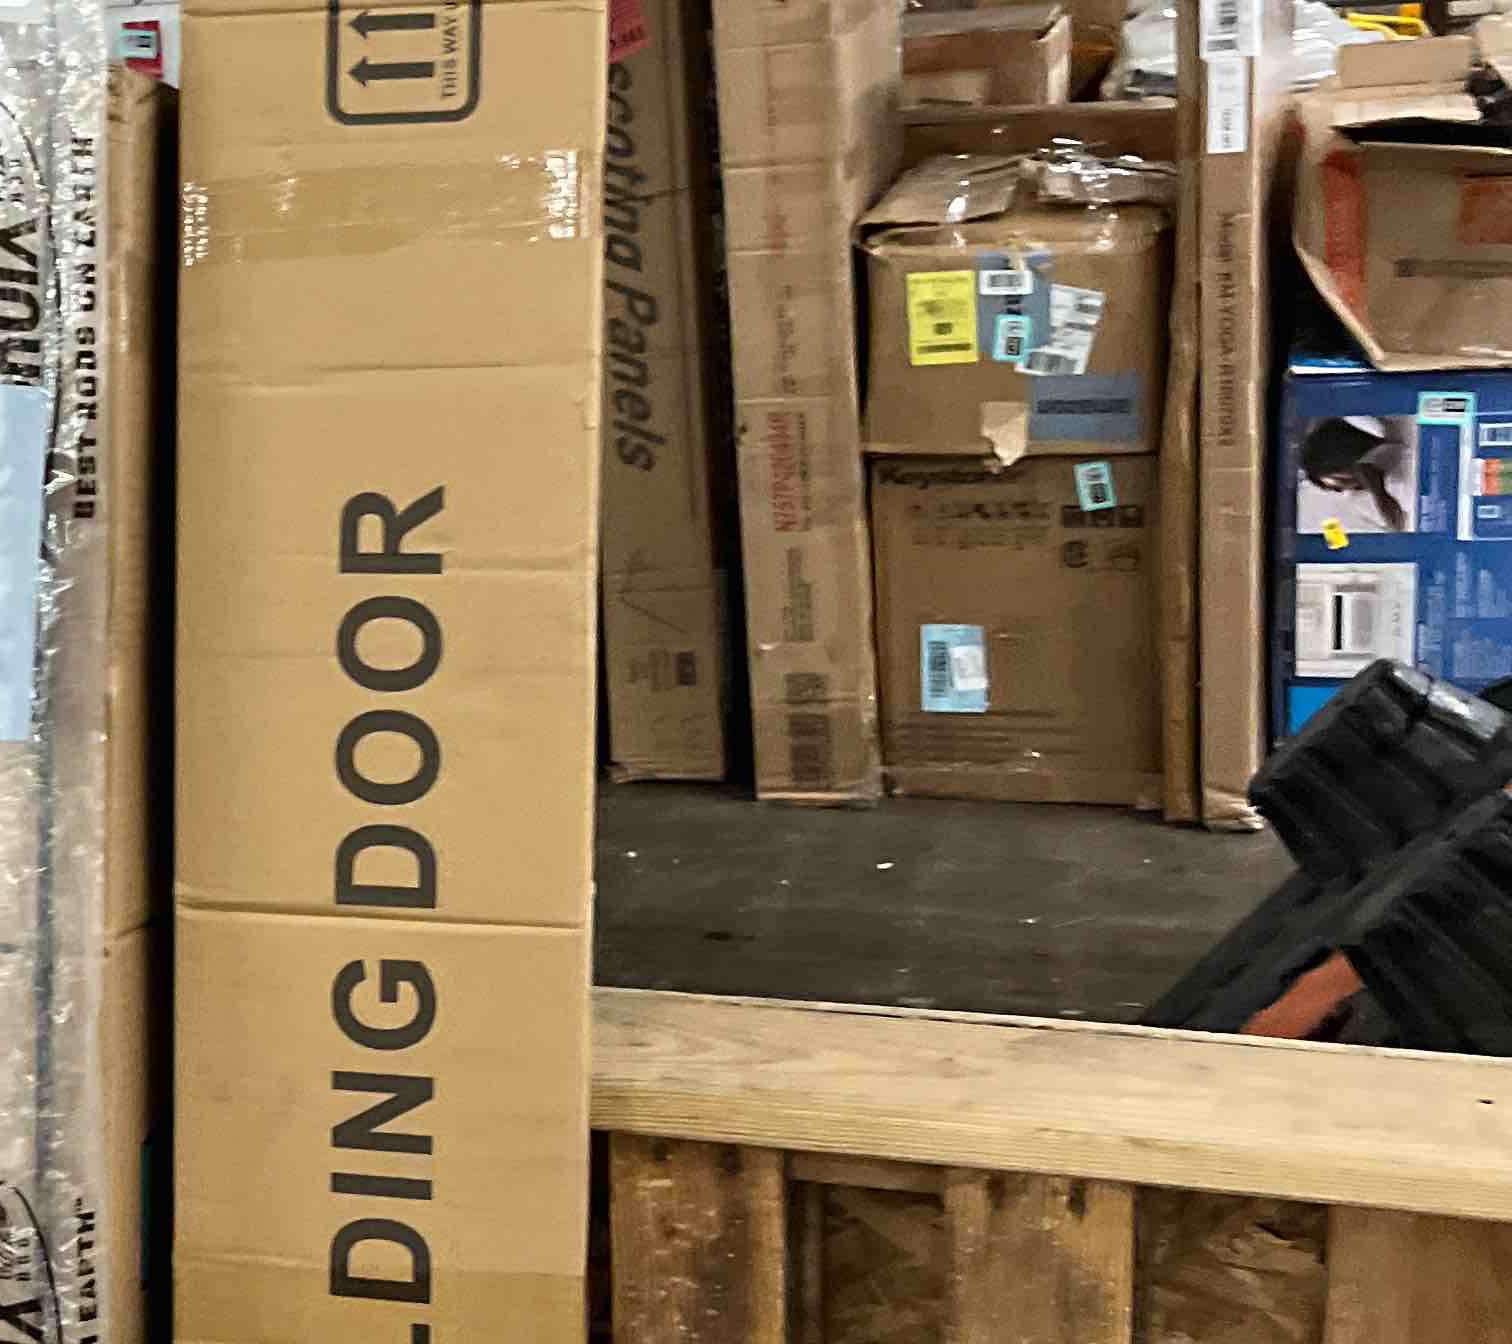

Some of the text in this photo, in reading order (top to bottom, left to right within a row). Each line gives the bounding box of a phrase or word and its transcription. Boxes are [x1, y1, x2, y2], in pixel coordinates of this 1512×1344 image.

[441, 64, 456, 100] THIS
[442, 19, 458, 60] WAY
[609, 280, 667, 473] Panels
[336, 487, 446, 908] DOOR
